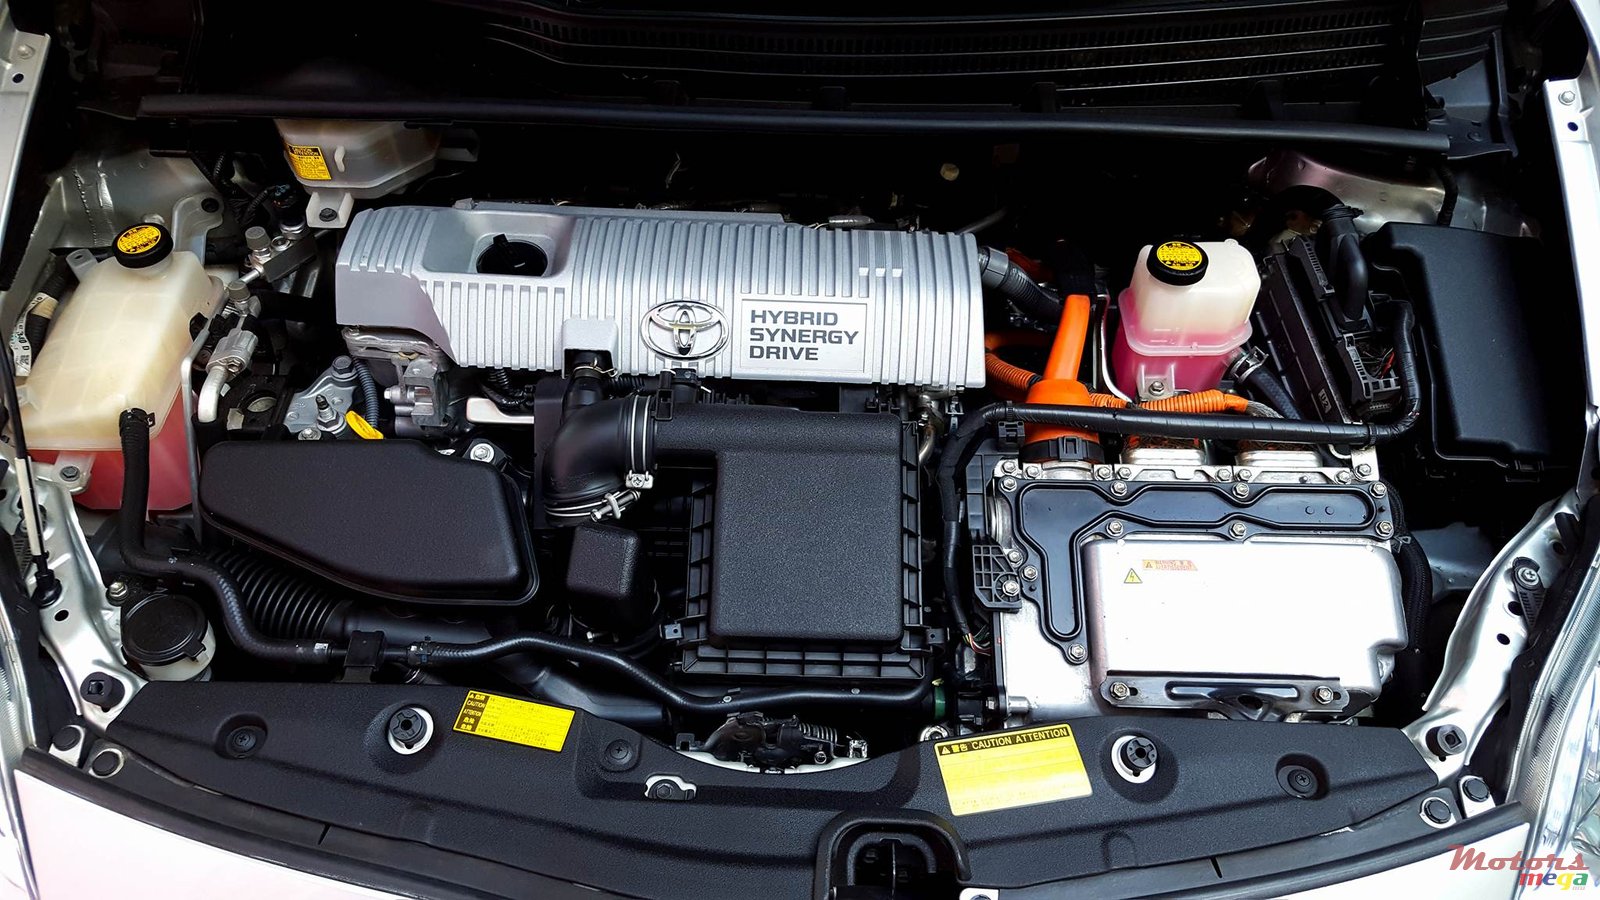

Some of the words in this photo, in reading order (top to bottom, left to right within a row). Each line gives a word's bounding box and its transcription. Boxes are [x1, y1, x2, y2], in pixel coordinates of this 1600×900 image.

[750, 309, 839, 326] HYBRID
[749, 327, 860, 345] SYNERGY
[749, 345, 819, 361] DRIVE
[971, 736, 1012, 750] CAUTION
[1015, 728, 1068, 743] ATTENTION
